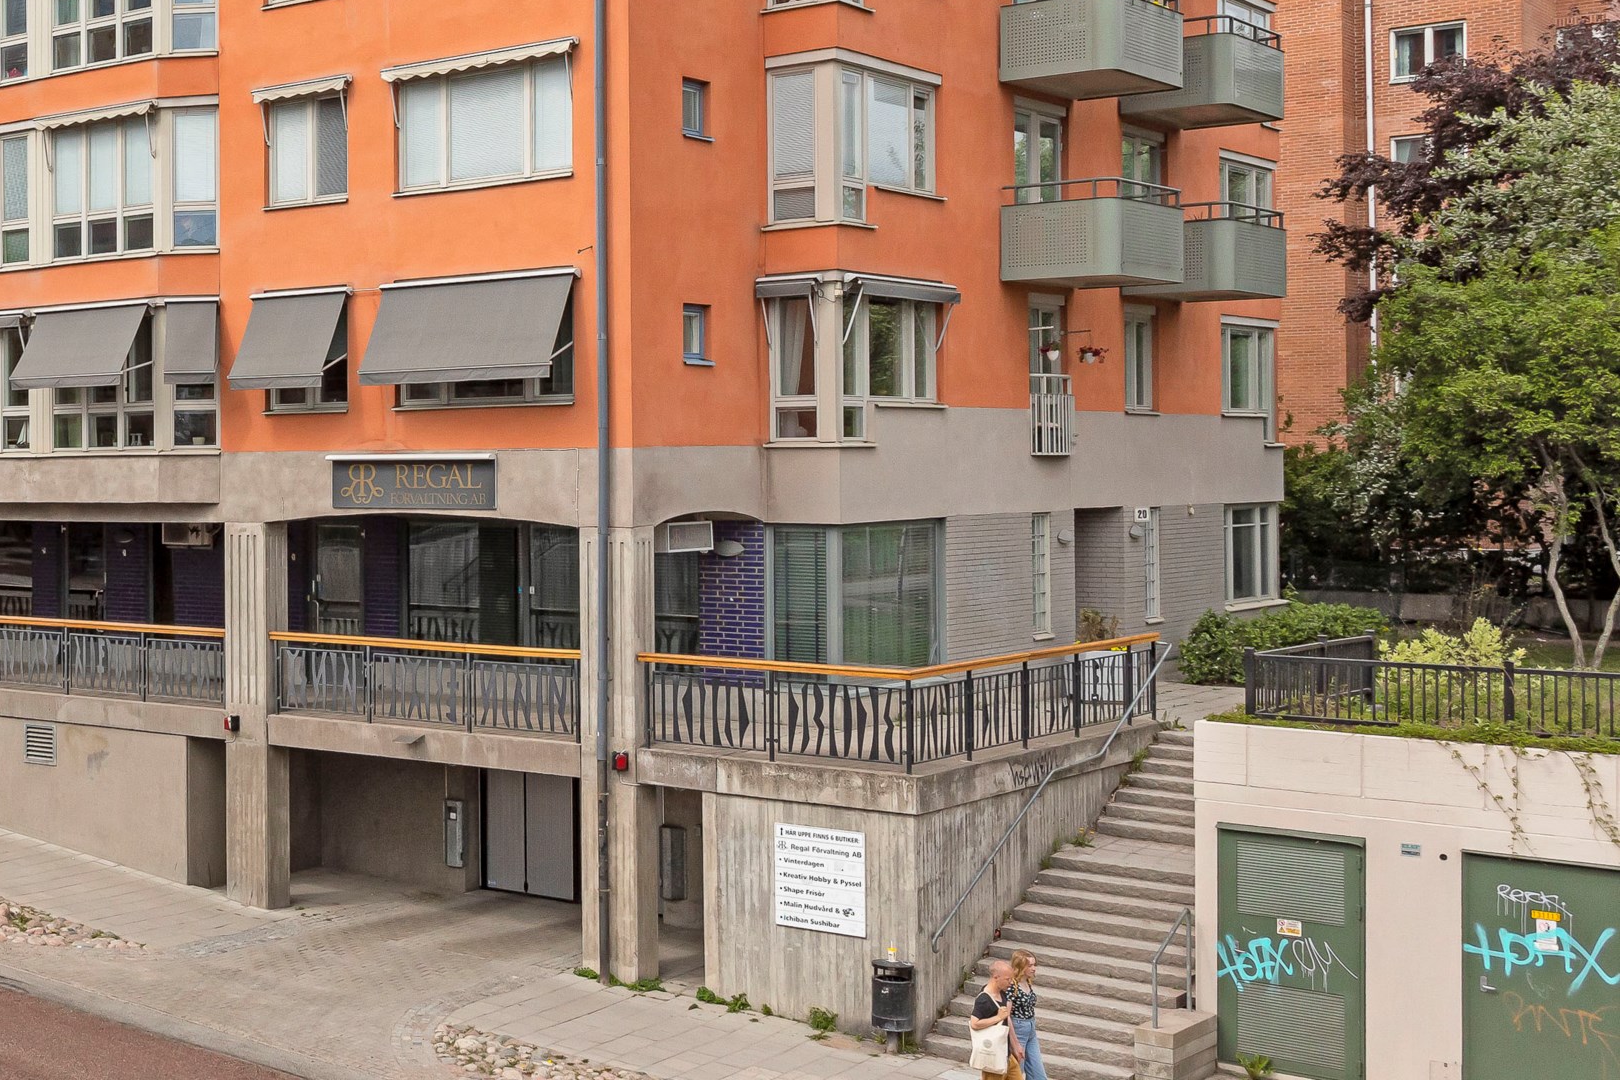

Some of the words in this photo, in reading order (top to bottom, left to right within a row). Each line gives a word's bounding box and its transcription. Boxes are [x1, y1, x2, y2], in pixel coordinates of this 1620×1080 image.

[395, 463, 482, 489] REGAL
[469, 492, 486, 505] AB
[1137, 509, 1148, 519] 20
[812, 832, 829, 841] FINNS
[790, 843, 810, 852] Regal
[812, 846, 850, 858] Förvaltning
[852, 851, 862, 859] AB
[783, 857, 825, 868] Vinterdagen
[783, 872, 807, 880] Kreativ
[808, 875, 832, 885] Hobby
[840, 879, 862, 888] Pyssel
[783, 886, 804, 895] Shape
[783, 900, 803, 908] Malin
[804, 903, 834, 913] Hudvård
[783, 914, 809, 923] Ichiban
[810, 918, 840, 928] Sushibar
